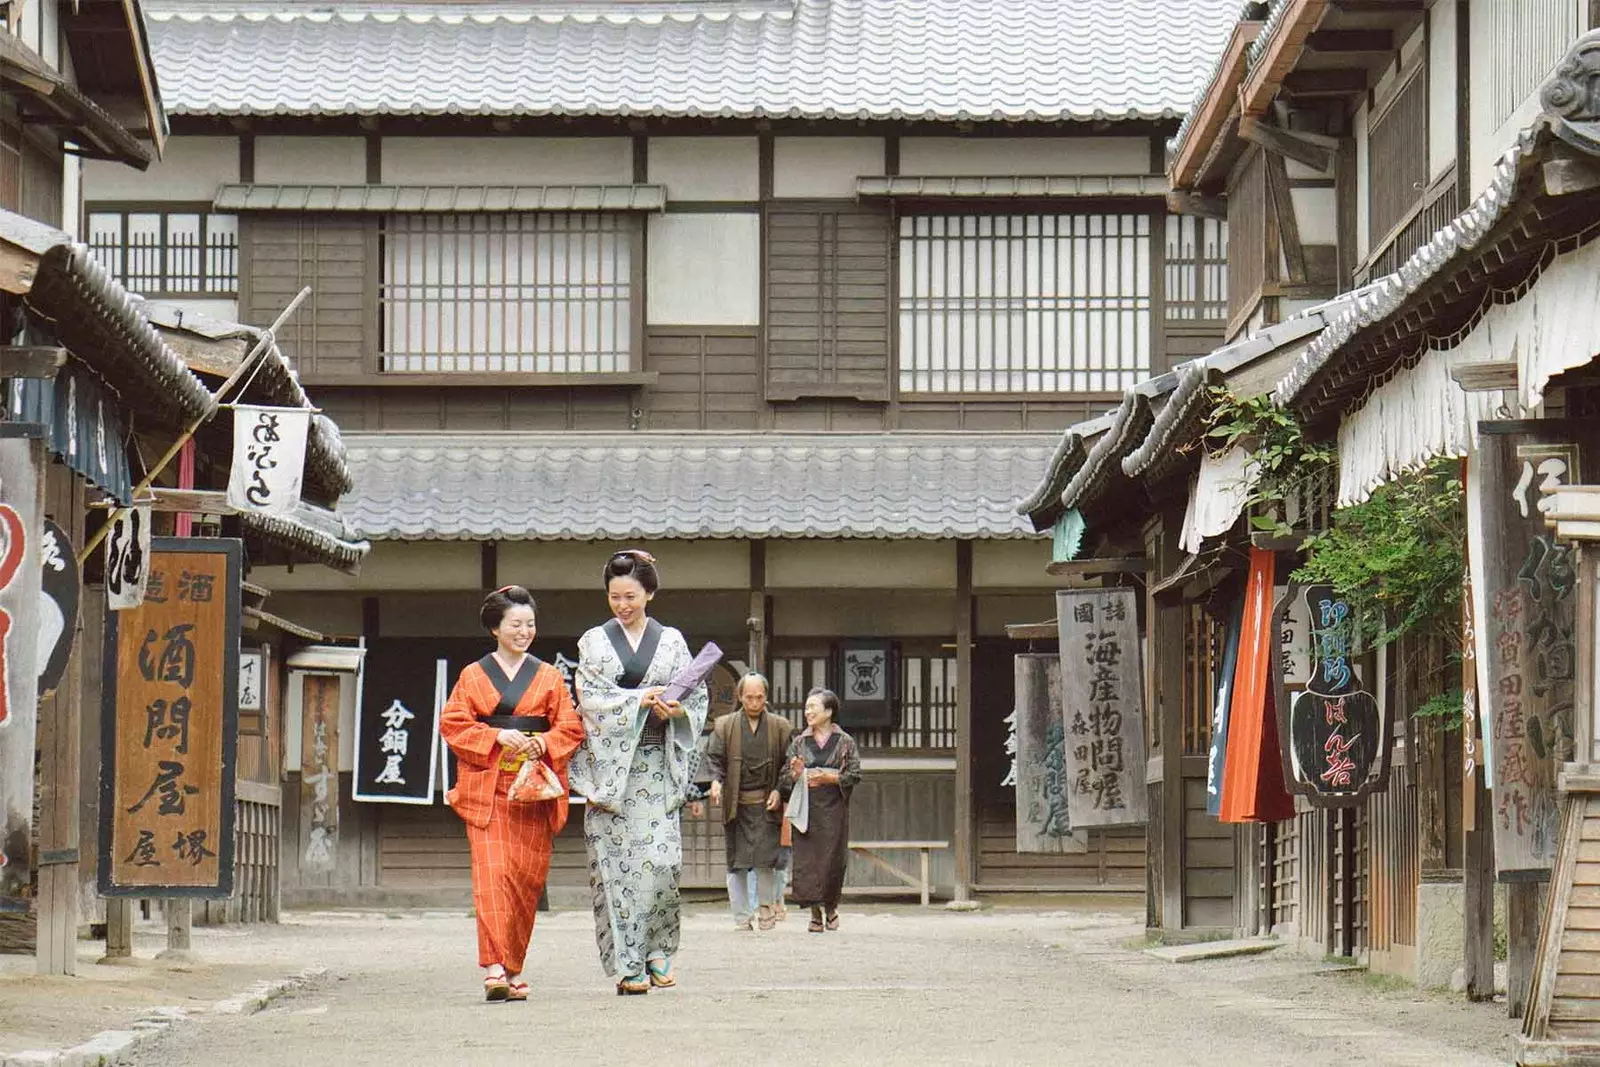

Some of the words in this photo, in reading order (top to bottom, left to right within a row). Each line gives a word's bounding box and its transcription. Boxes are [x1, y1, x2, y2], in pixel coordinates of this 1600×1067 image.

[128, 624, 199, 816] 酒問屋
[374, 699, 415, 785] 分銅屋
